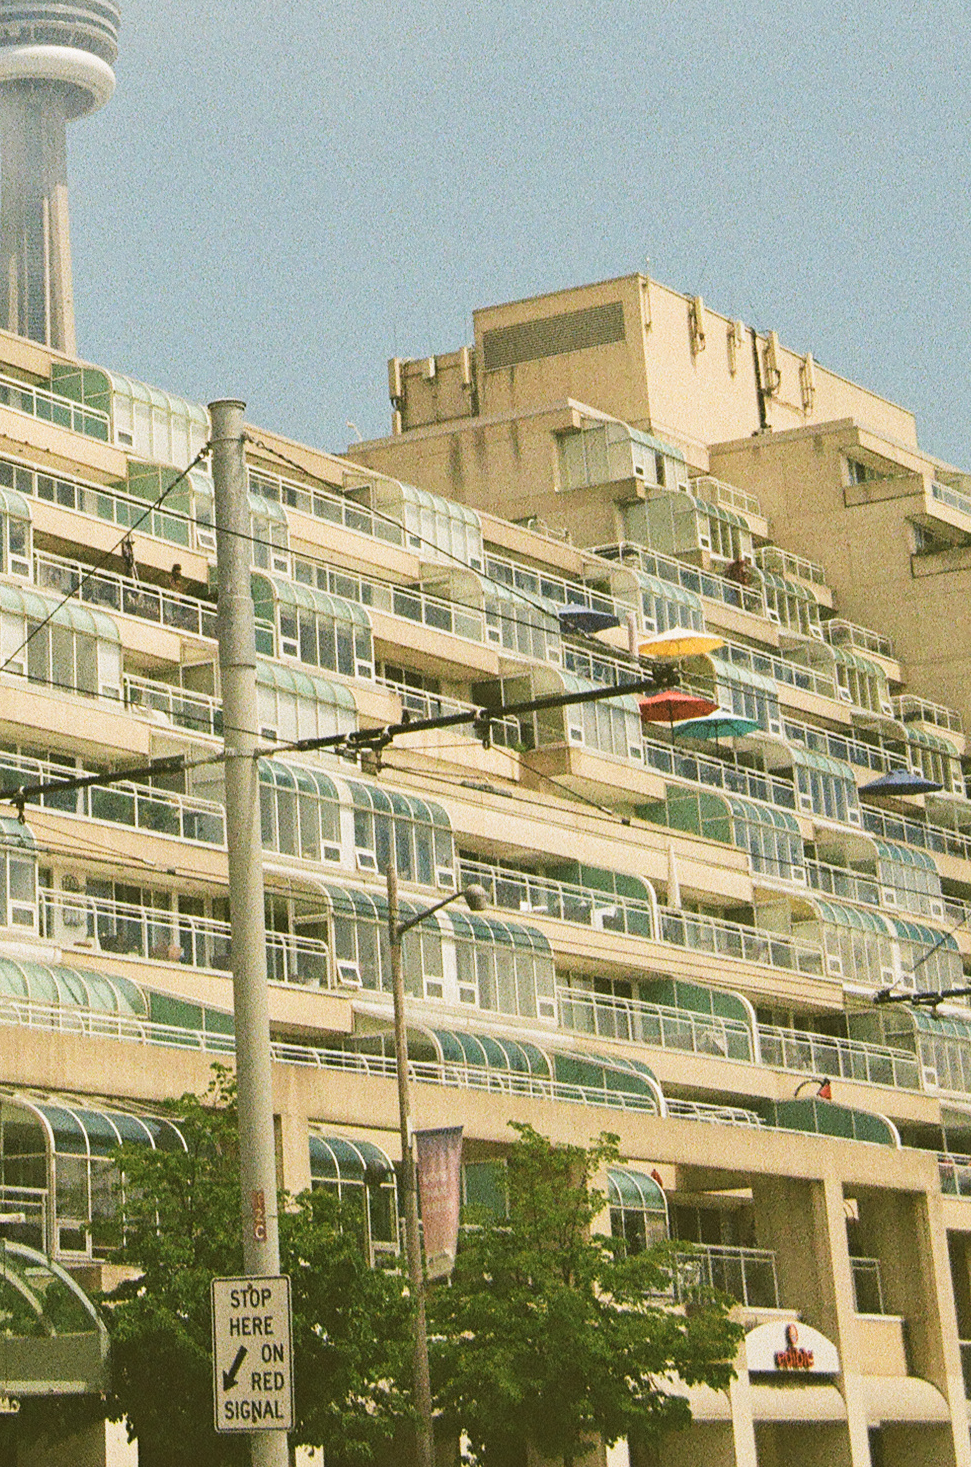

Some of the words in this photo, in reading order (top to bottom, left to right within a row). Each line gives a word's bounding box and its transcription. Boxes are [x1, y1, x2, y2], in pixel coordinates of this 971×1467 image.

[230, 1288, 272, 1308] STOP
[229, 1316, 274, 1336] HERE
[261, 1343, 284, 1363] ON
[251, 1371, 285, 1391] RED
[224, 1400, 284, 1420] SIGNAL
